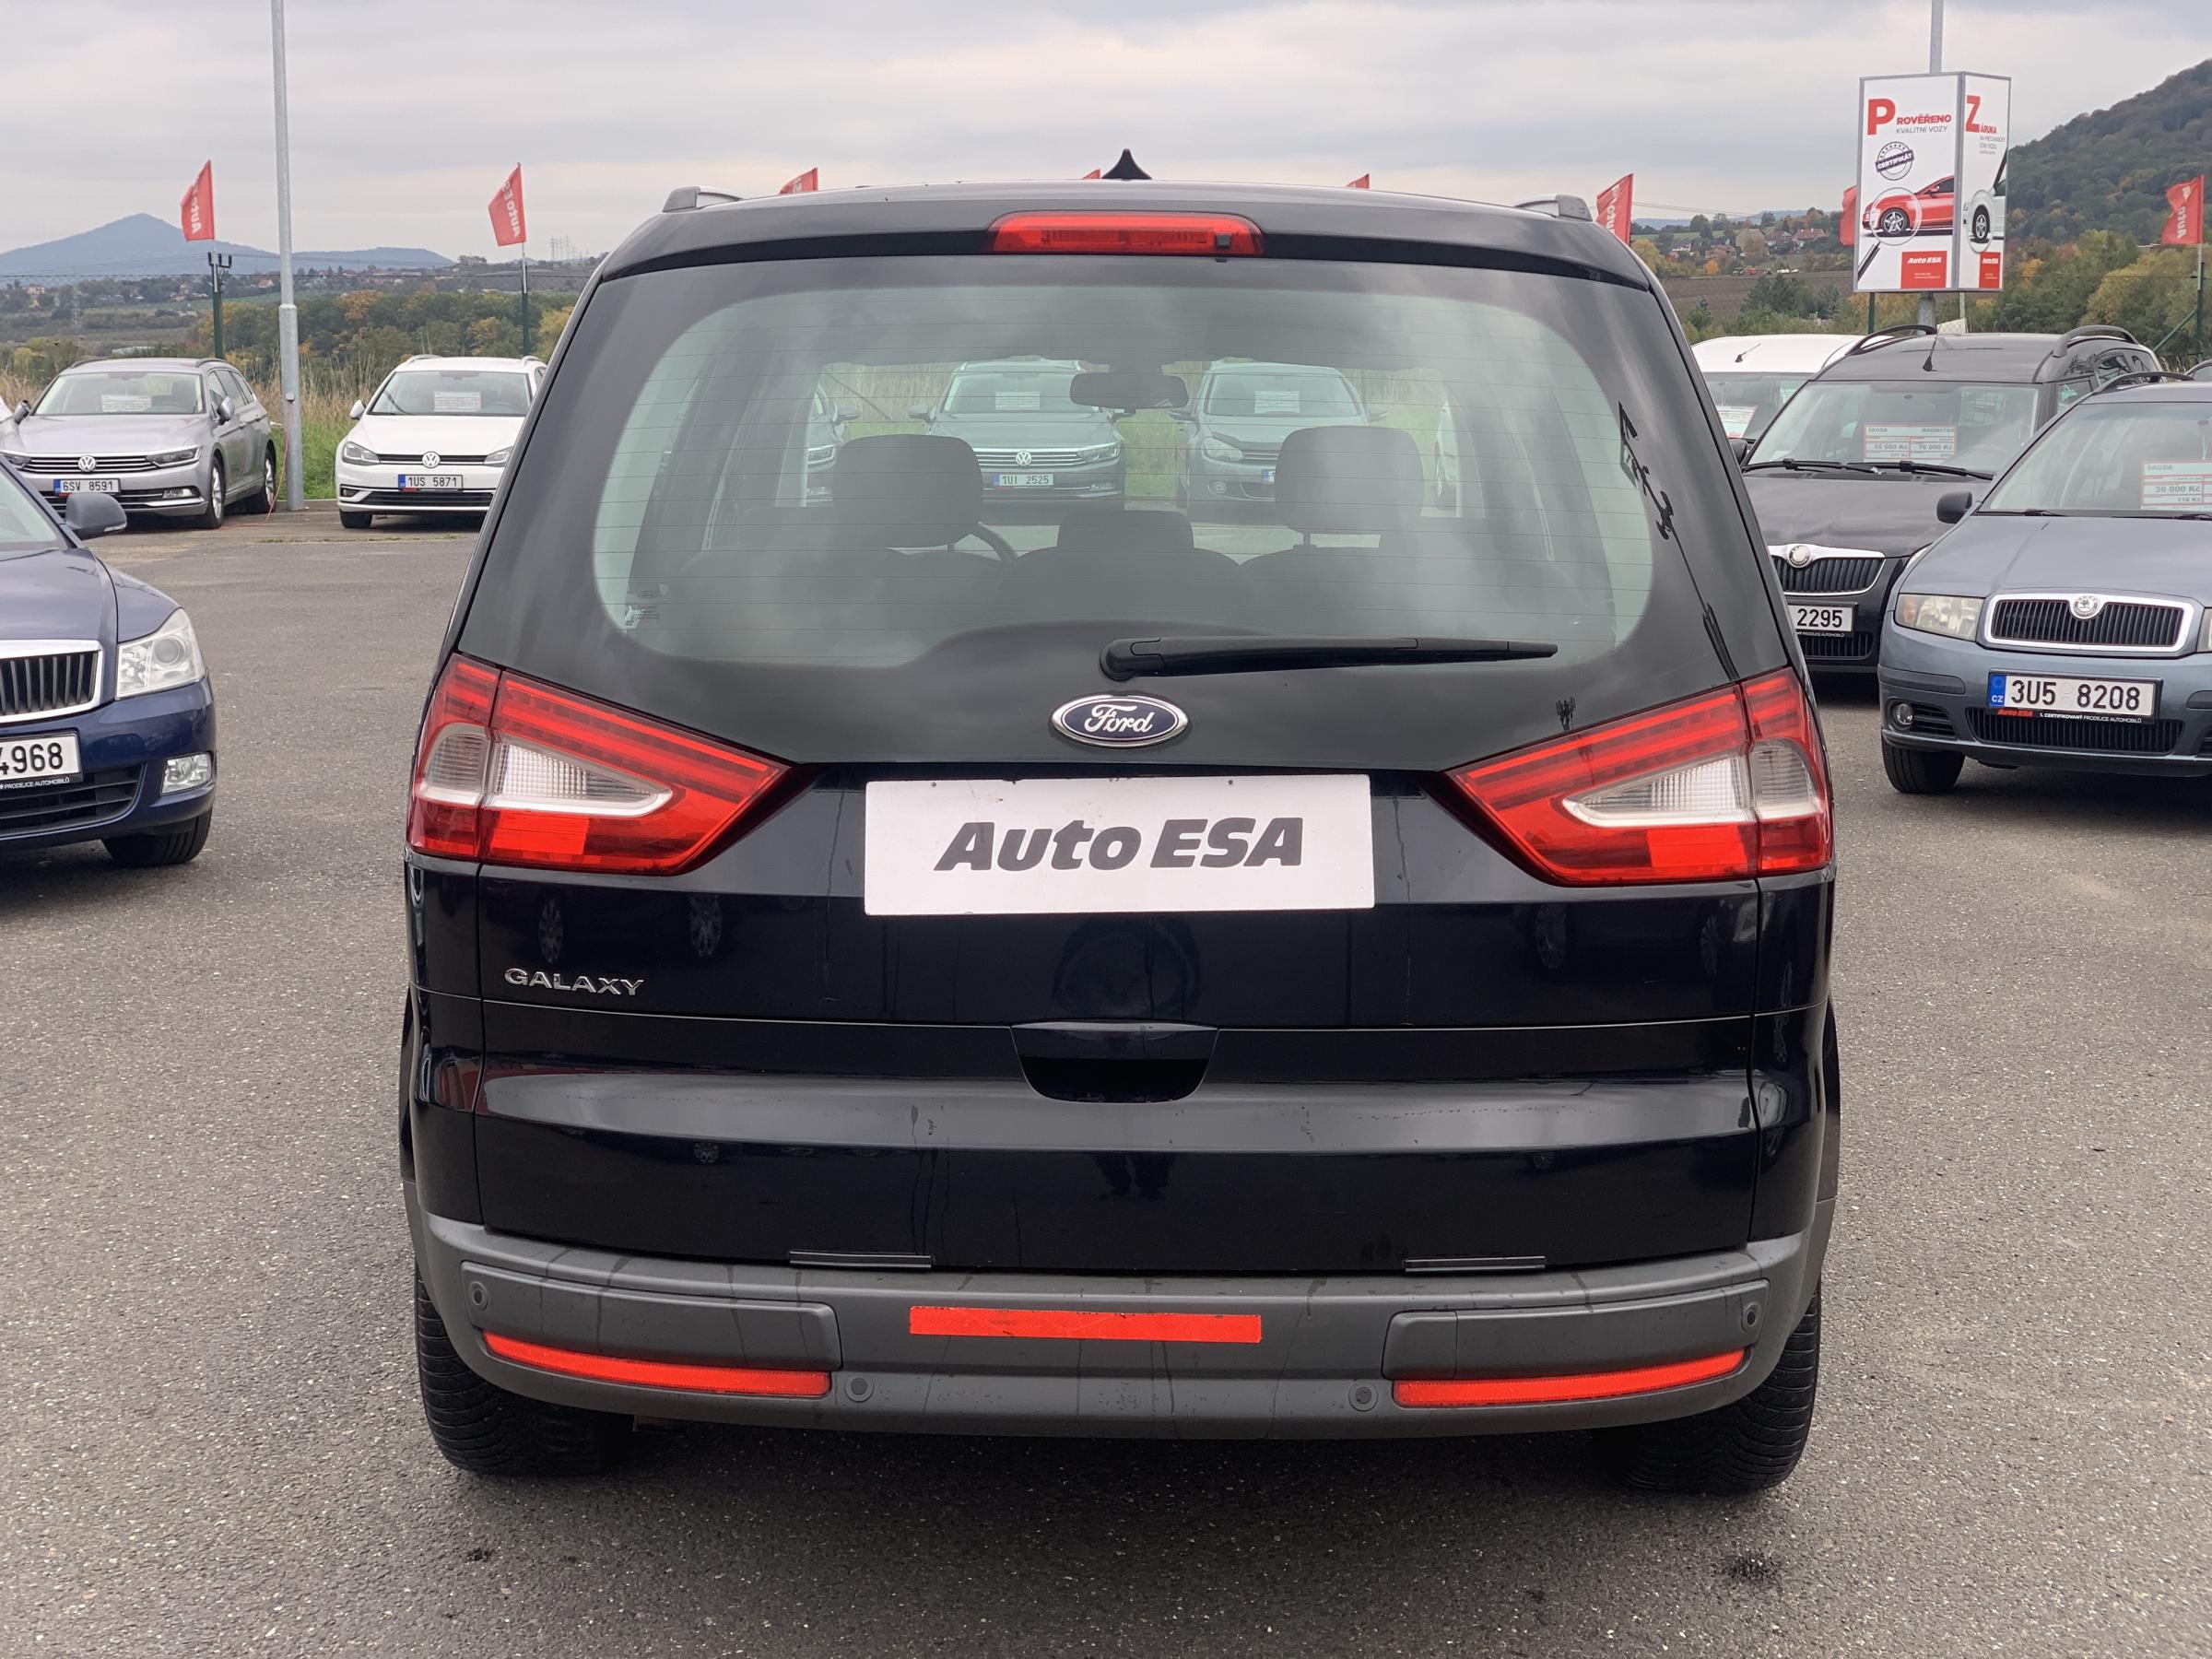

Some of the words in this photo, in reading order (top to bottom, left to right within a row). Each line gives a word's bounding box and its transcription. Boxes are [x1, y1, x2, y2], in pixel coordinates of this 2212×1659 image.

[63, 481, 81, 491] 6SV
[88, 481, 113, 491] 8591
[408, 477, 426, 487] 1US
[432, 477, 457, 487] 5871
[1026, 476, 1050, 485] 2525
[1796, 607, 1843, 628] 2295
[1992, 695, 2004, 703] CZ
[2011, 679, 2057, 706] 3U5
[2077, 683, 2141, 712] 8208
[1084, 703, 1155, 733] Ford
[4, 782, 34, 790] PRODEJCE
[34, 776, 70, 787] AUTOMOBILŮ
[934, 819, 1142, 871] Auto
[1149, 817, 1303, 868] ESA
[504, 968, 644, 995] GALAXY
